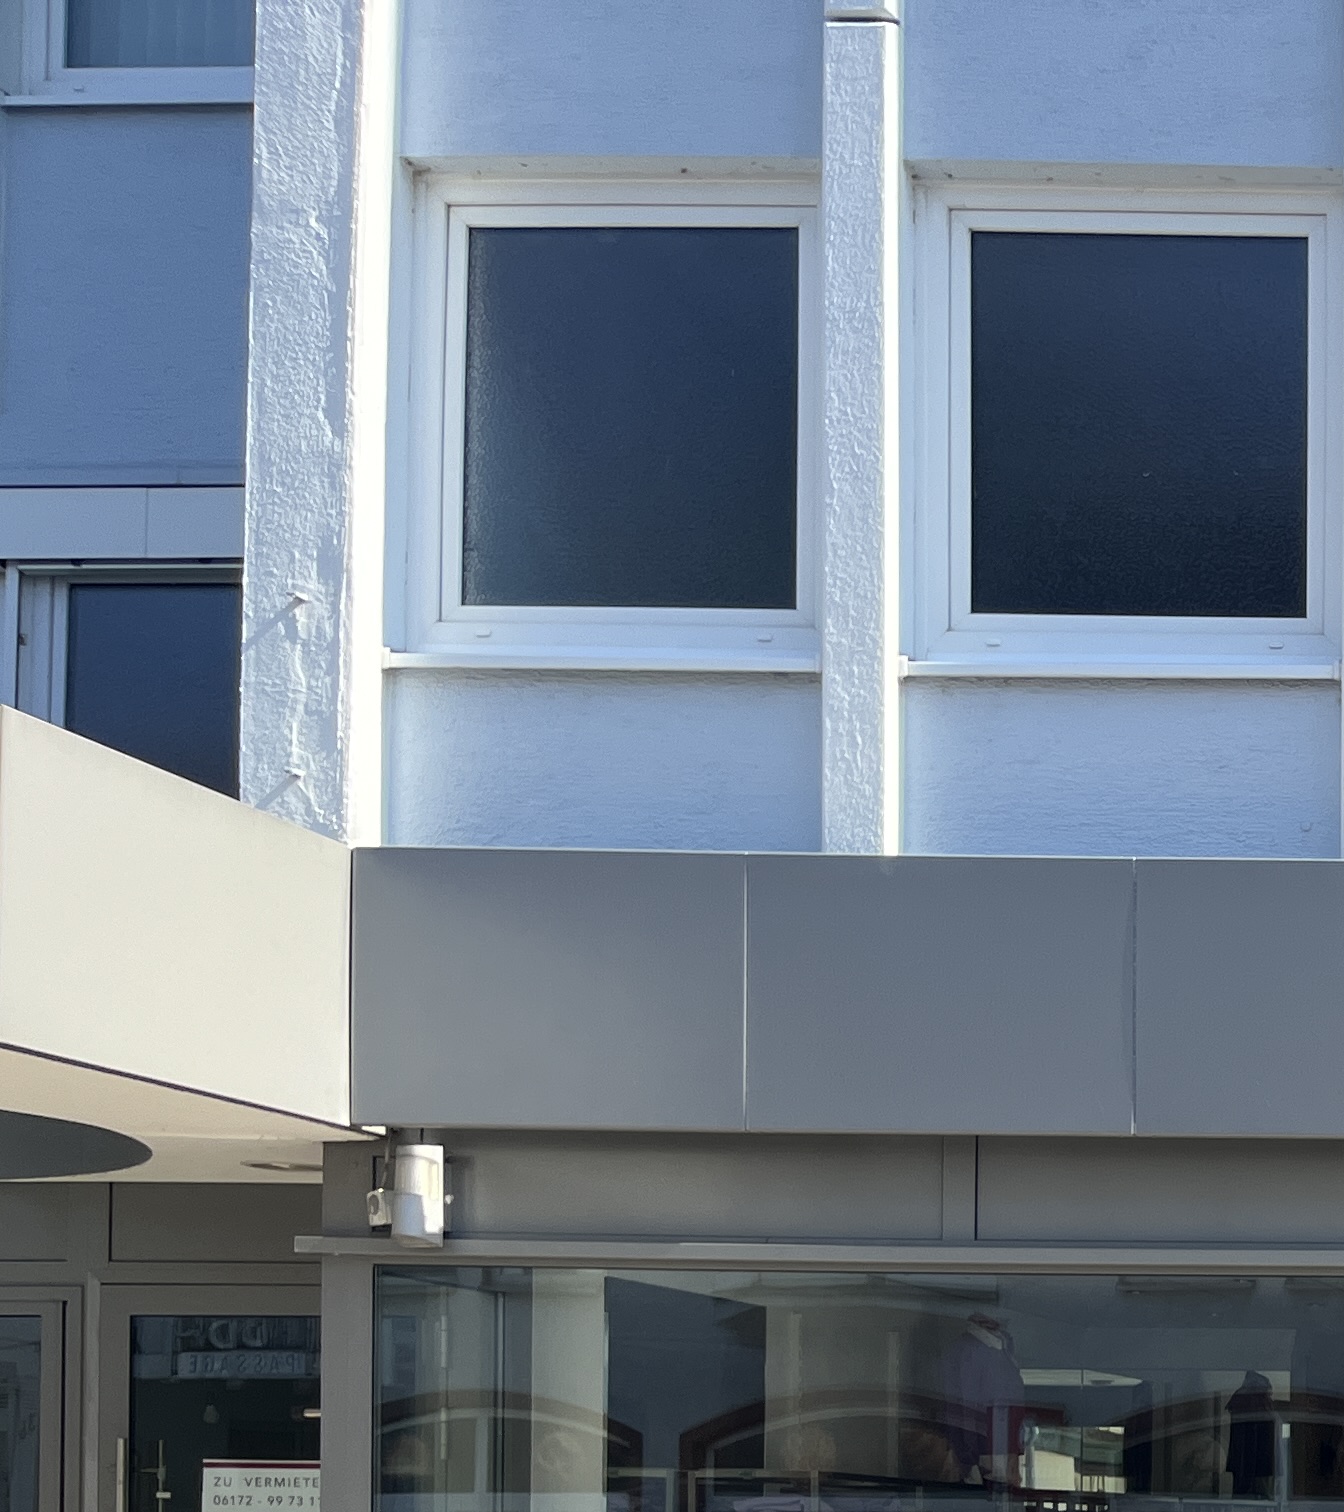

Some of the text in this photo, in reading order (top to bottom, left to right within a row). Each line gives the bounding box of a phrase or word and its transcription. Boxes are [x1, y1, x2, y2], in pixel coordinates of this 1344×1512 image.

[213, 1476, 320, 1489] ZU VERMIETE
[213, 1495, 253, 1506] 06172
[267, 1496, 284, 1507] 99
[288, 1496, 304, 1507] 73
